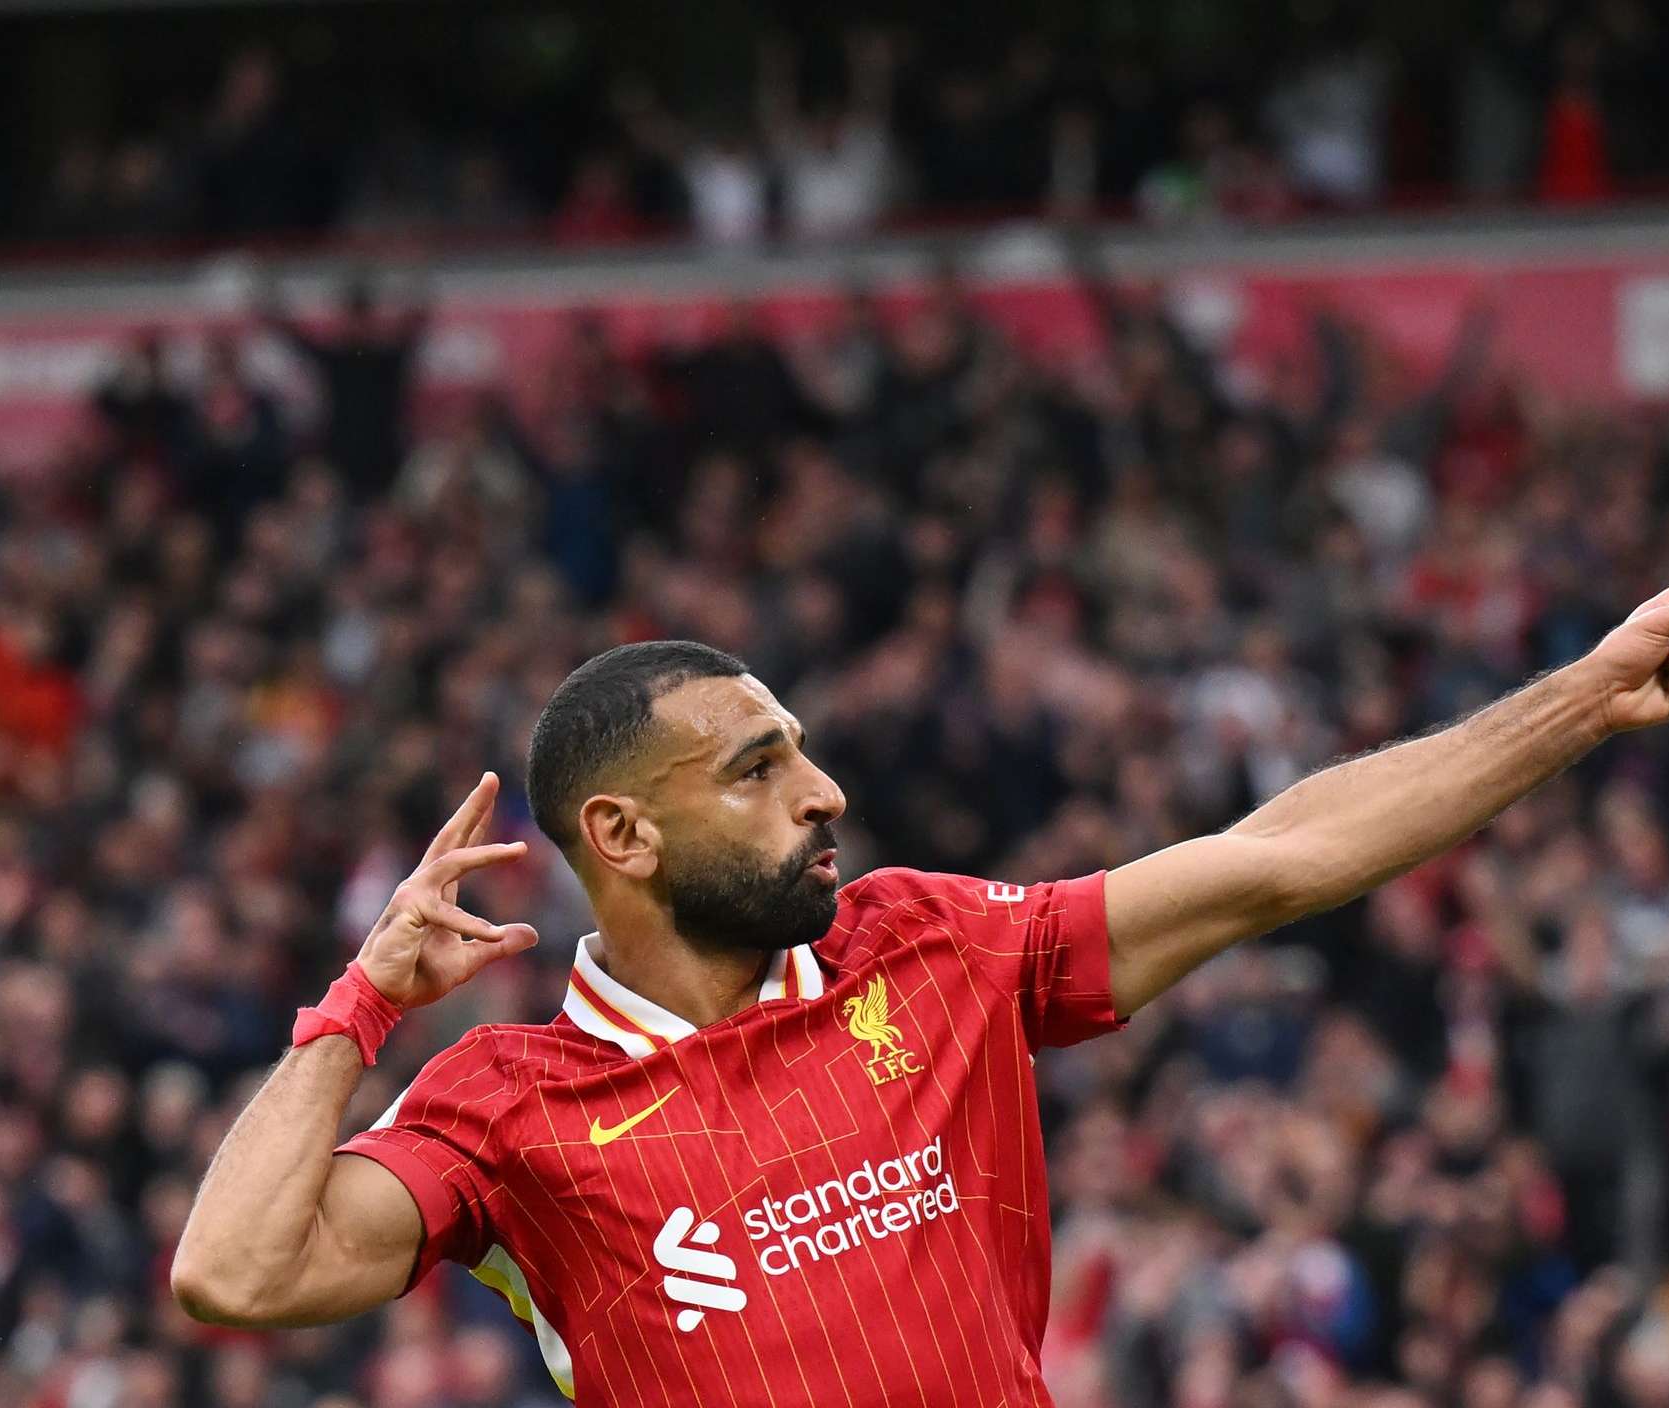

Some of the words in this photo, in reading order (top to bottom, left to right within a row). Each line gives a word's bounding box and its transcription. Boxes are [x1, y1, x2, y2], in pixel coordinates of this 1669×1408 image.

[866, 1052, 924, 1085] L.F.C.
[743, 1135, 942, 1240] standard
[759, 1173, 959, 1275] chartered
